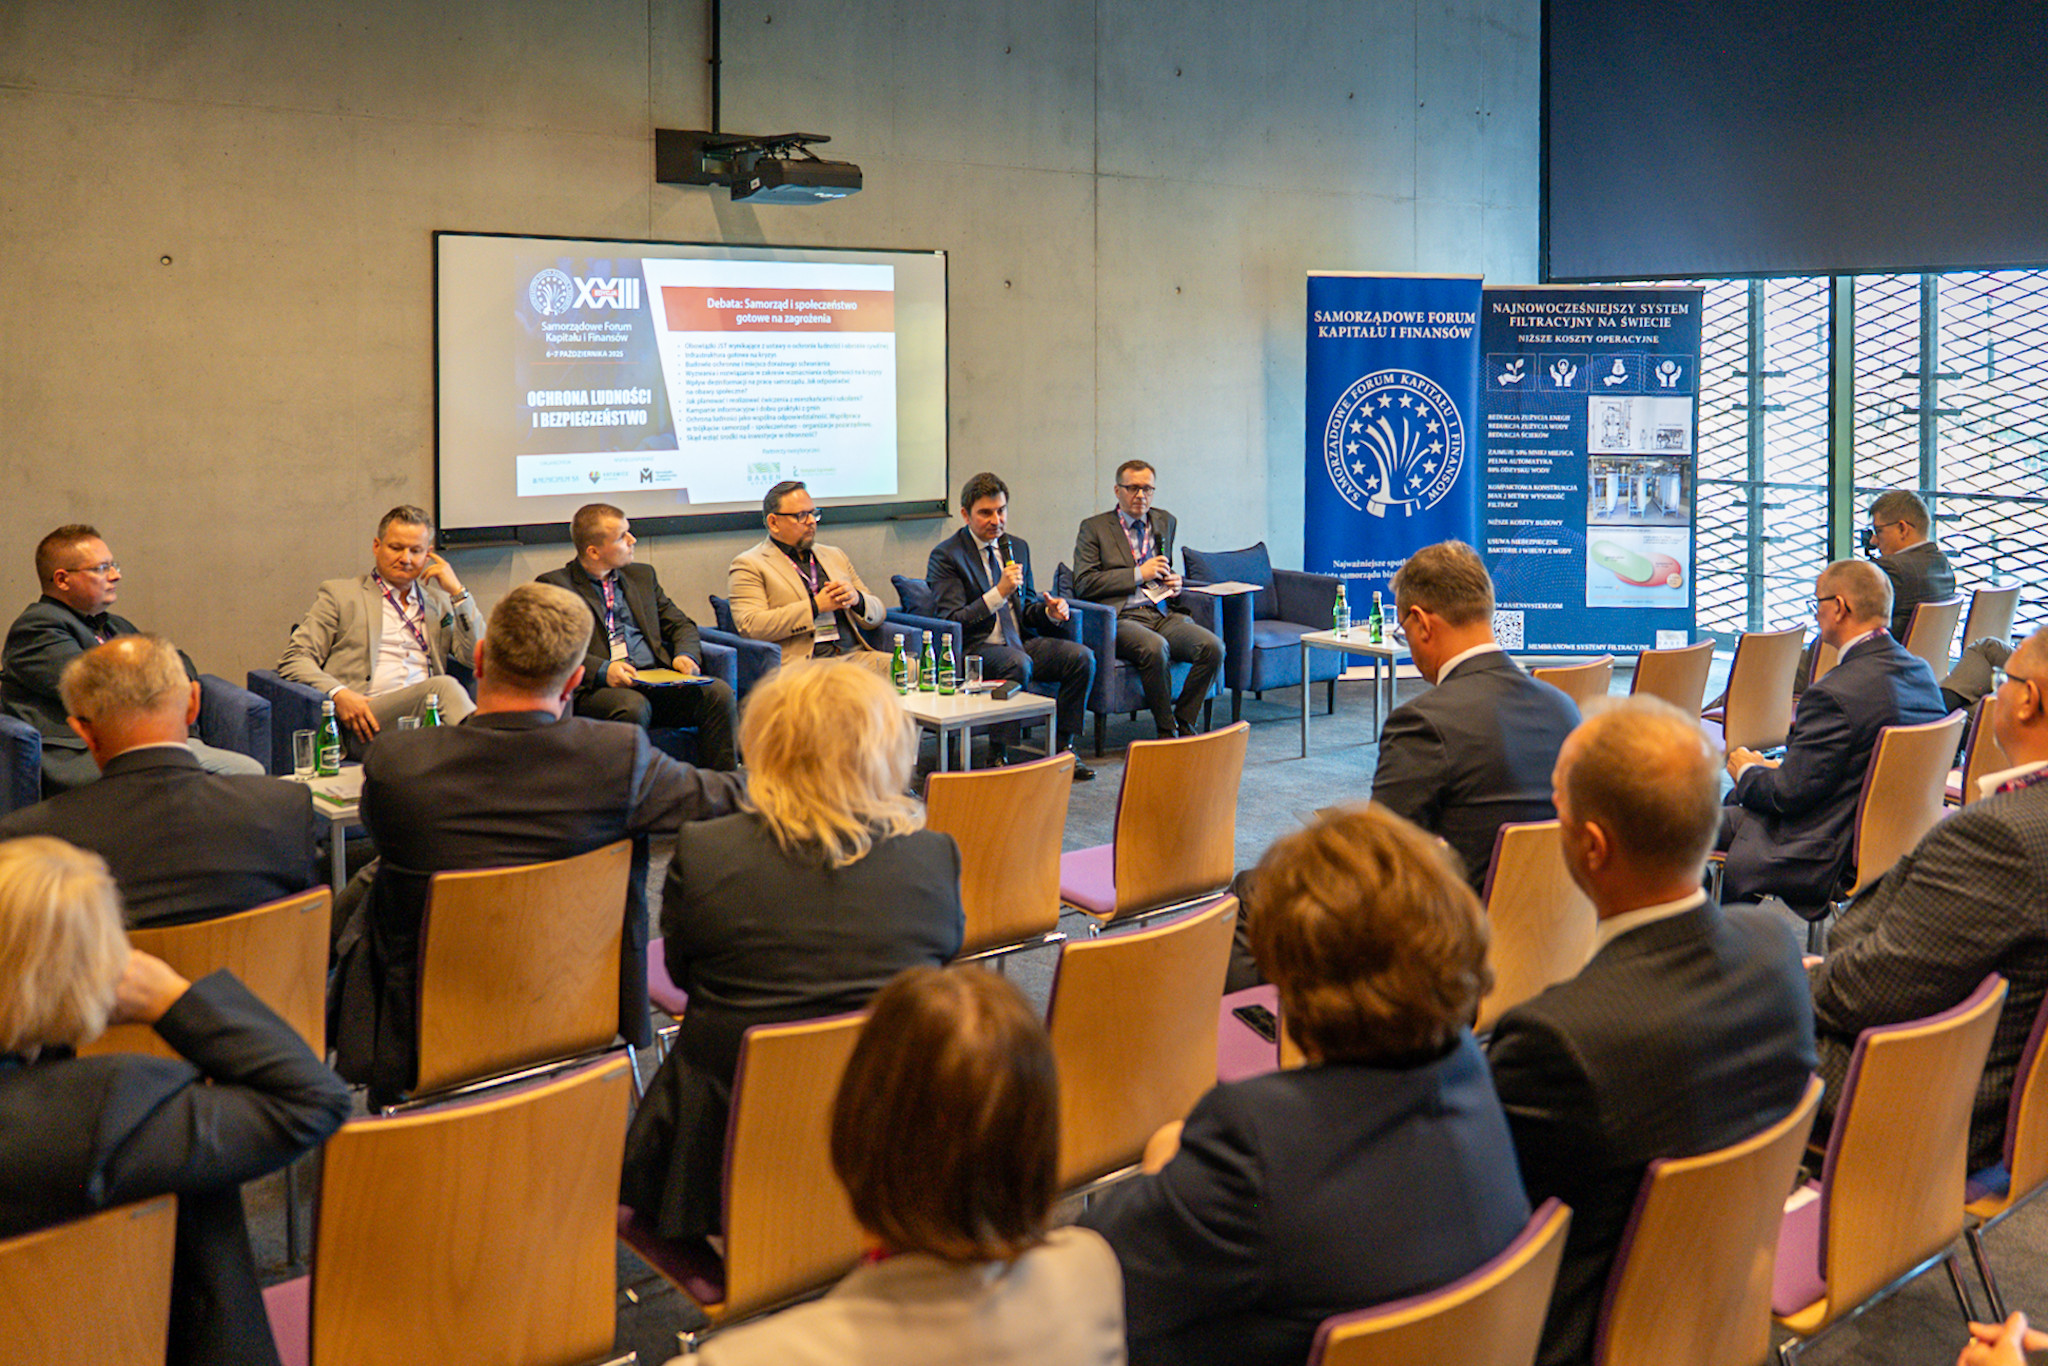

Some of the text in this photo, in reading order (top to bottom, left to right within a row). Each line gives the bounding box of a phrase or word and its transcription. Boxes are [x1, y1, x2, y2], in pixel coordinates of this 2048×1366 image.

[706, 298, 858, 311] Debata: Samorząd i społeczeństwo
[1492, 302, 1689, 315] NAJNOWOCZEŚNIEJSZY SYSTEM
[736, 314, 832, 325] gotowe na zagrożenia
[1314, 310, 1476, 326] SAMORZĄDOWE FORUM
[1509, 316, 1672, 329] FILTRACYJNY NA ŚWIECIE
[542, 322, 632, 333] Samorządowe Forum
[1318, 325, 1472, 339] KAPITAŁU I FINANSÓW
[546, 332, 581, 344] Kapitału
[588, 332, 629, 342] Finansów
[1518, 334, 1659, 344] NIŻSZE KOSZTY OPERACYJNE
[527, 387, 652, 407] OCHRONA LUDNOŚCI
[532, 408, 648, 428] I BEZPIECZEŃSTWO
[1329, 399, 1360, 502] SAMORZĄDOWE
[1350, 374, 1395, 399] FORUM
[1400, 374, 1454, 417] KAPITAŁU
[1427, 433, 1460, 501] FINANSÓW
[1333, 560, 1386, 569] Najważniejsze
